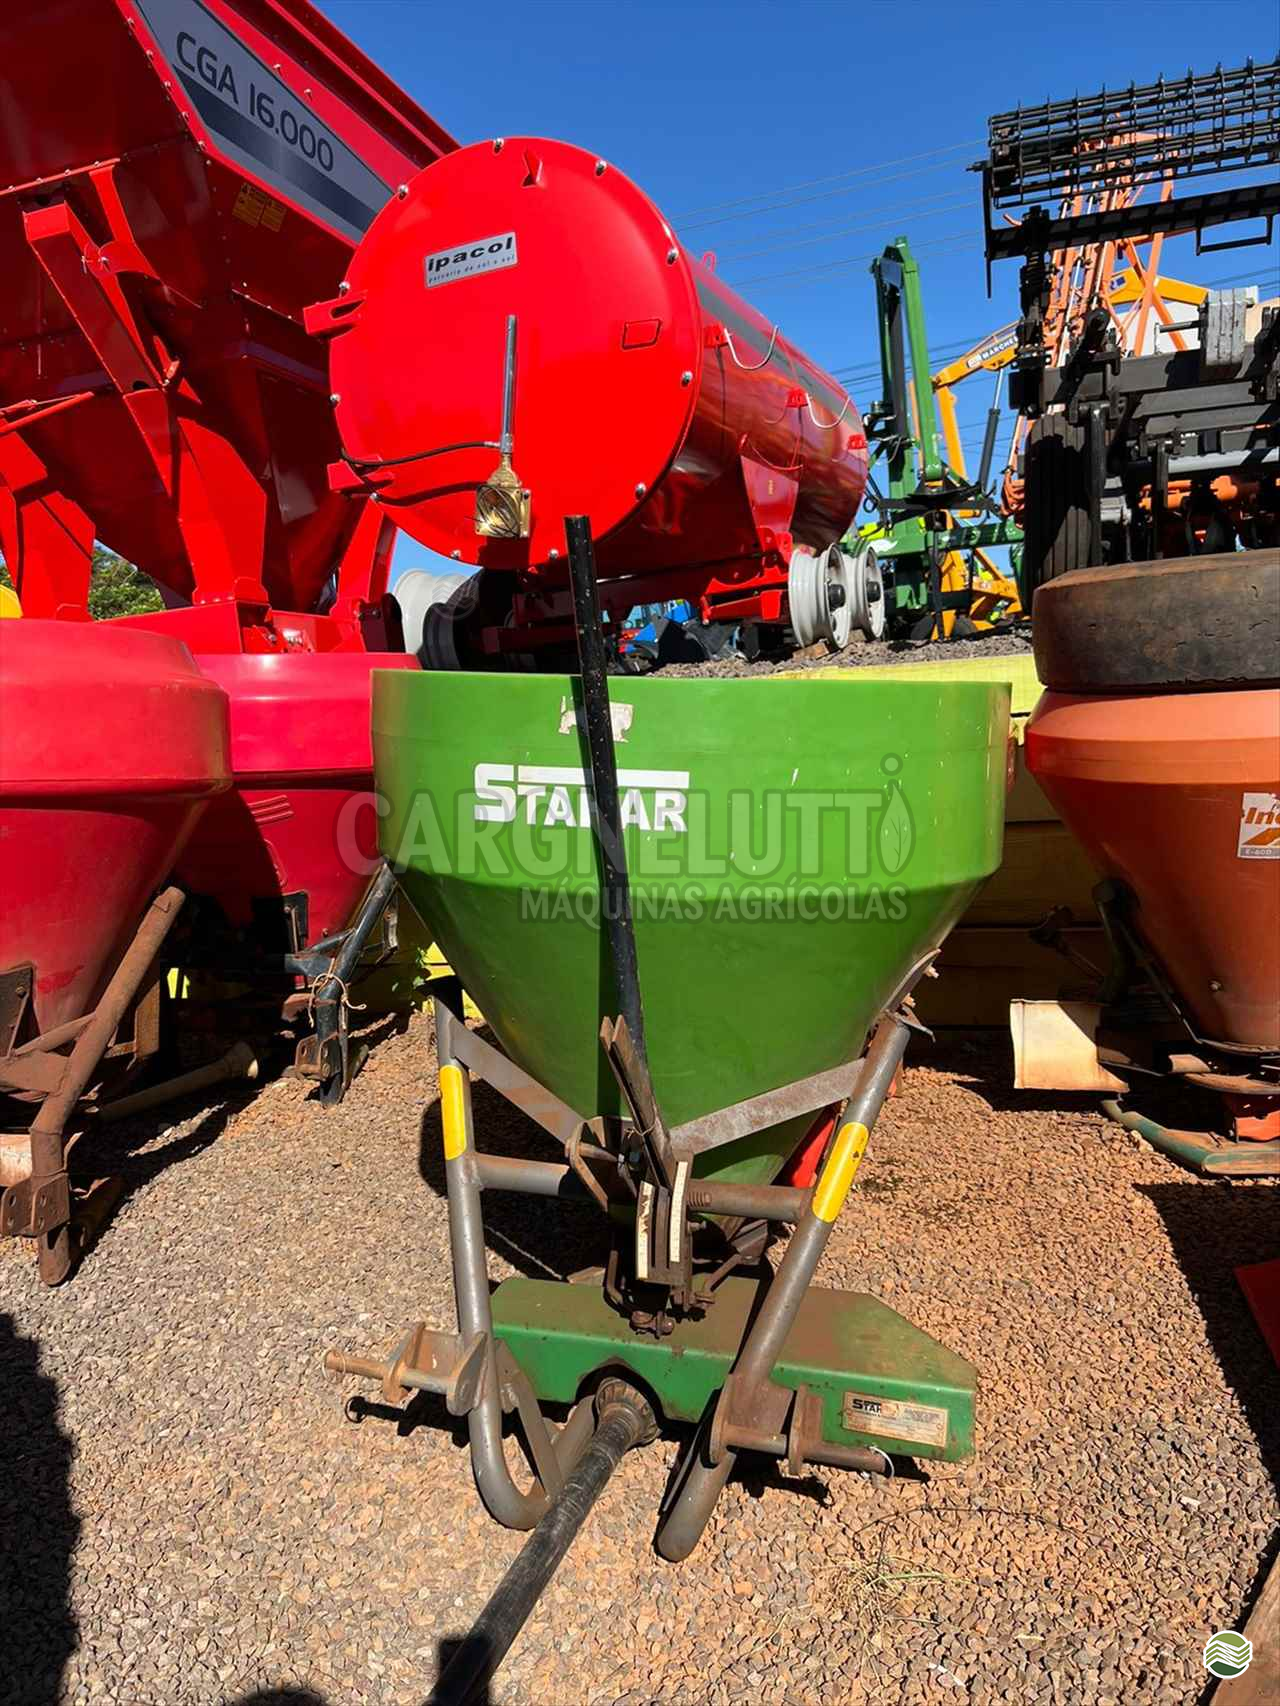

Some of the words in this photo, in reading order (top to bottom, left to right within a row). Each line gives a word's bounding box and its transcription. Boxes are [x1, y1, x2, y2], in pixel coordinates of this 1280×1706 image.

[176, 31, 239, 105] CGA
[249, 83, 334, 172] 16.000
[428, 236, 513, 273] ipacol
